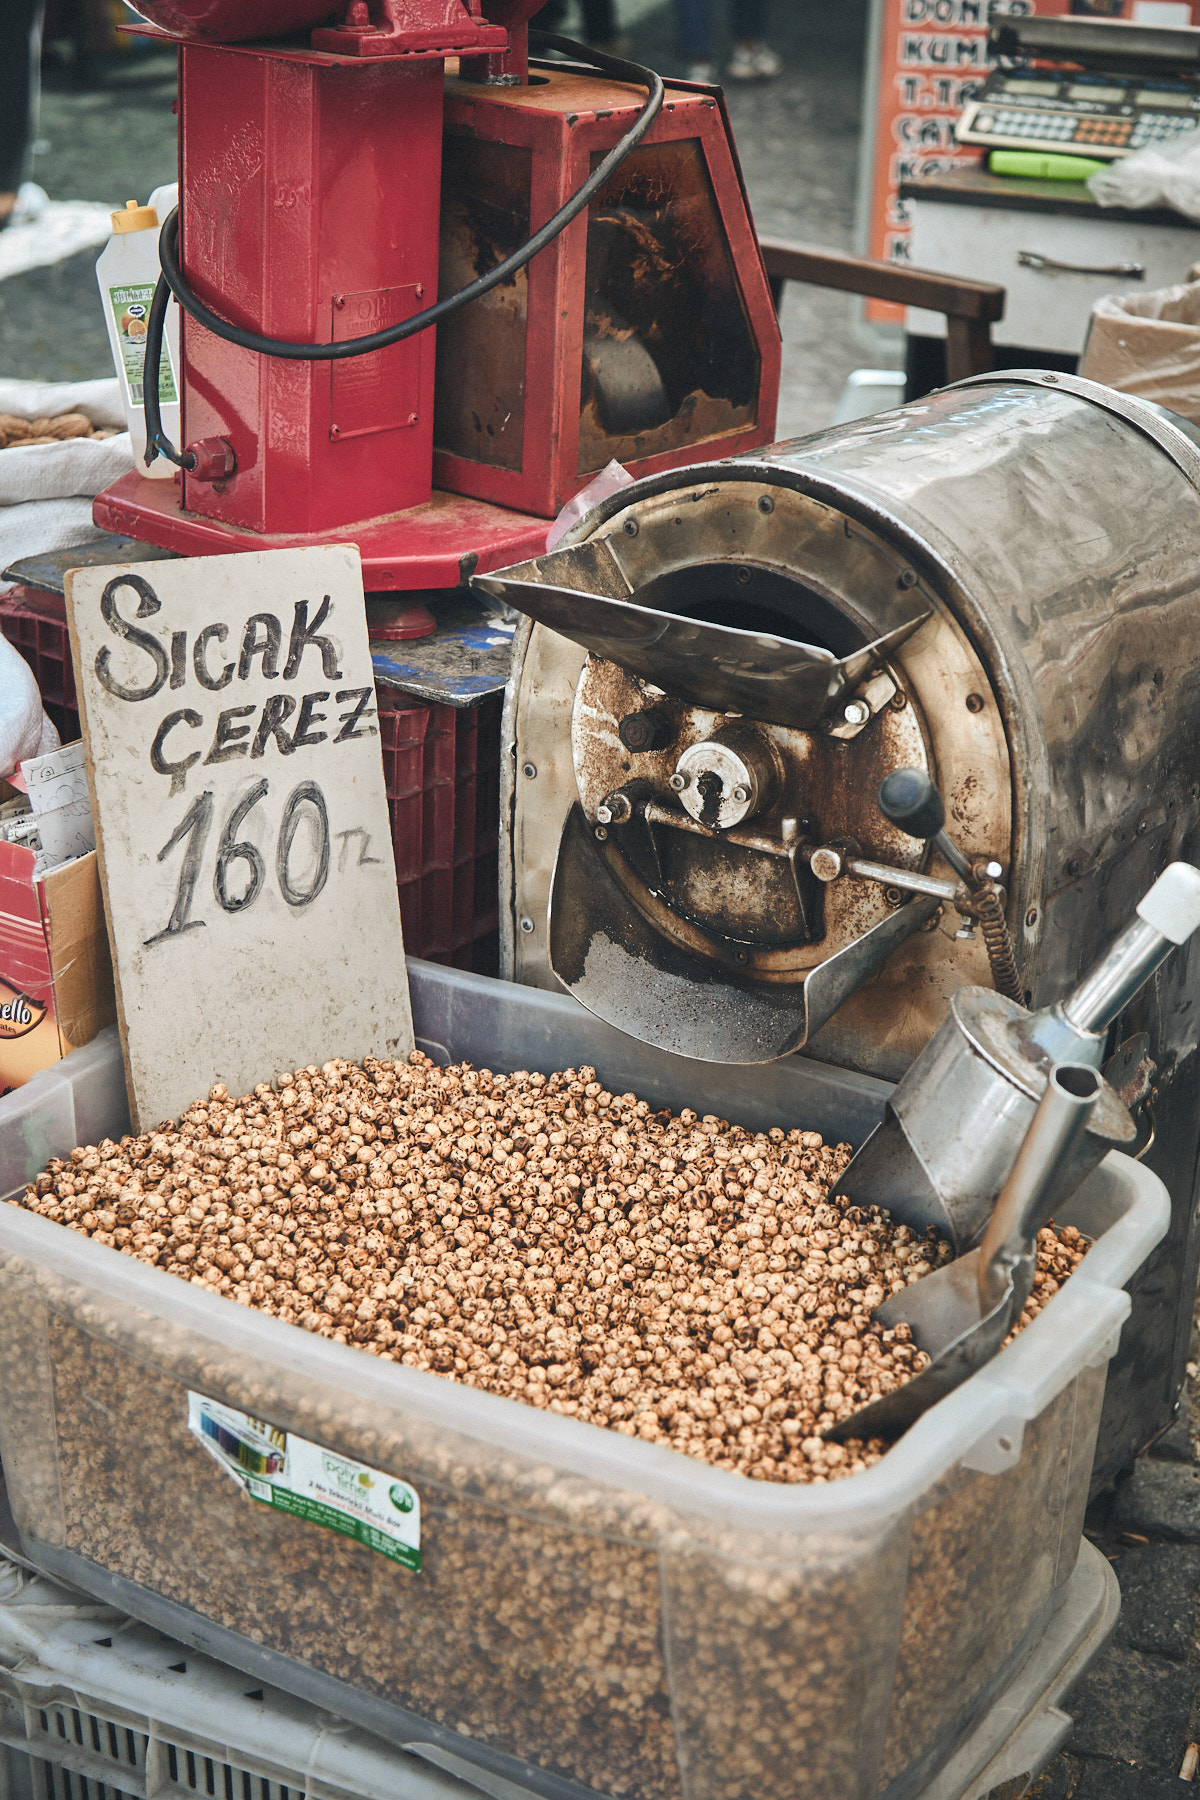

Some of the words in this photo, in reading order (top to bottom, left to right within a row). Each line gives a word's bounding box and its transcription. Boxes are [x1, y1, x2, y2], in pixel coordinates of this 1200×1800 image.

[150, 686, 378, 797] ÇEREZ
[143, 778, 331, 946] 160
[0, 998, 32, 1025] ello
